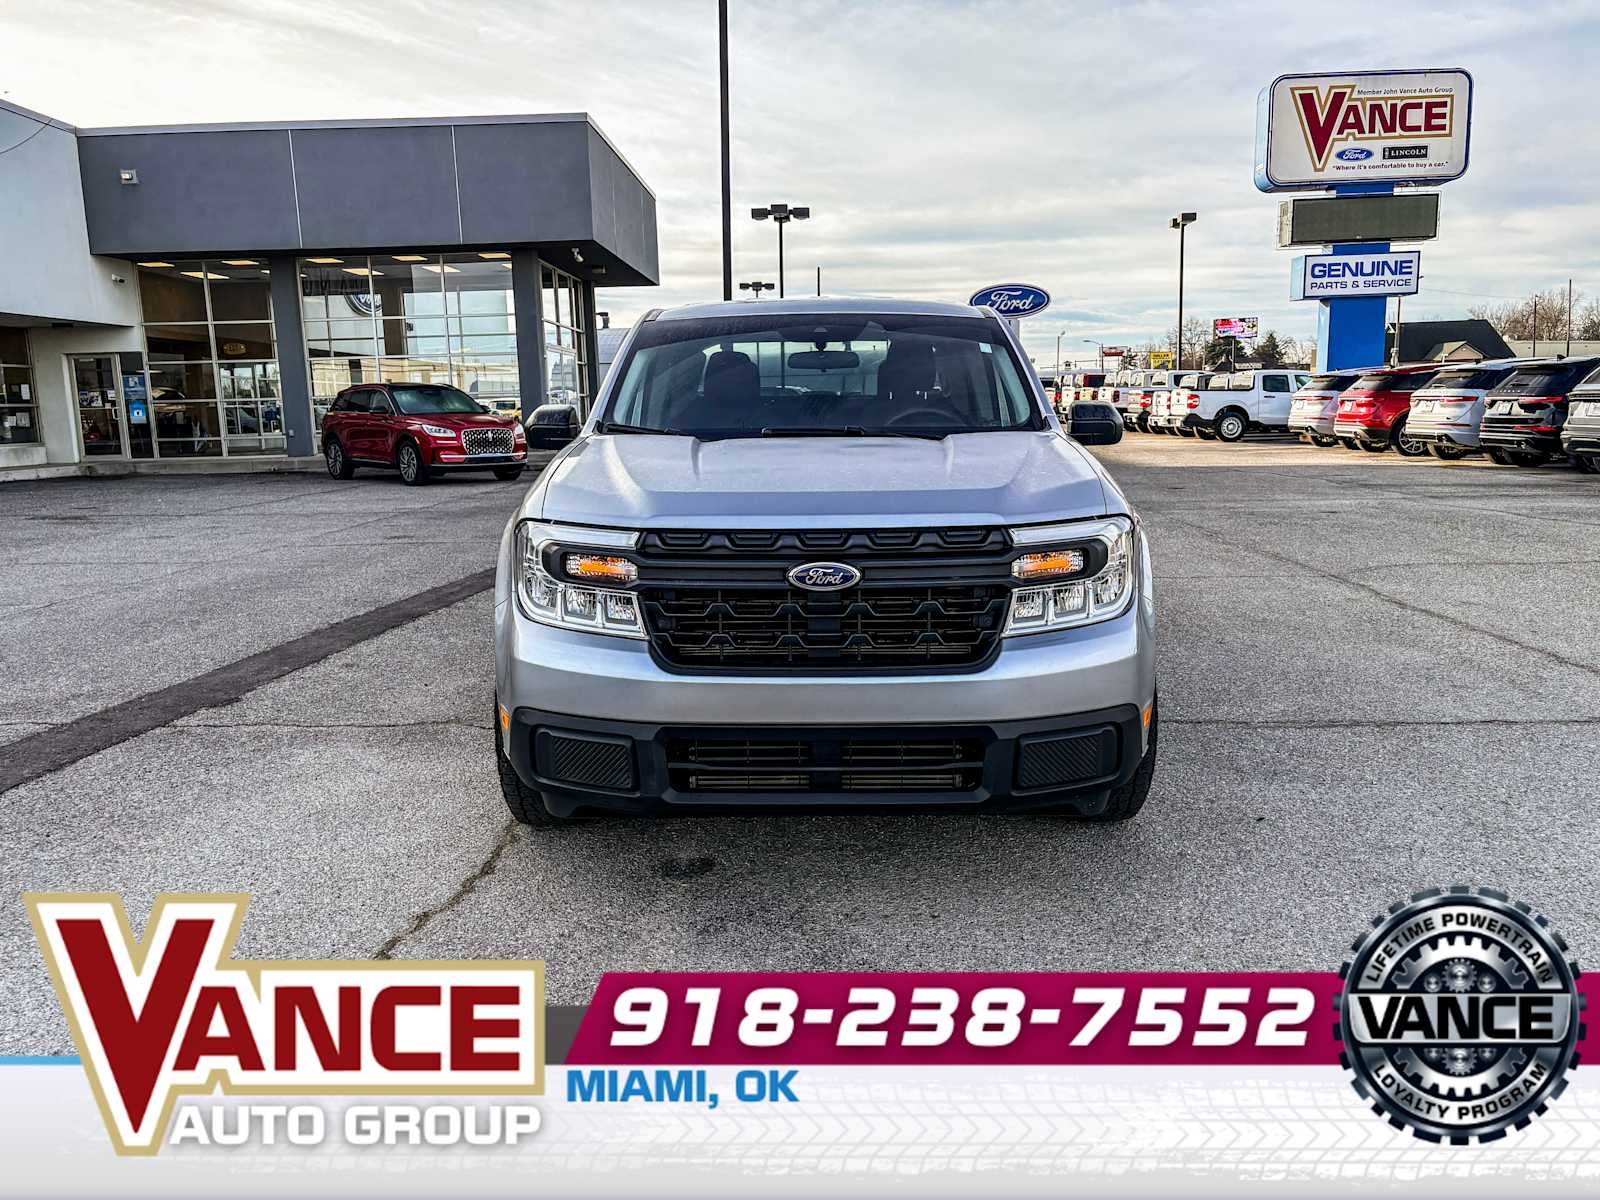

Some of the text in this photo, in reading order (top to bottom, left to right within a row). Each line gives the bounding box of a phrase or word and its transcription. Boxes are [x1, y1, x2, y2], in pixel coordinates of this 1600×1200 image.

[1298, 91, 1448, 164] VANCE
[1342, 150, 1367, 160] Ford
[1310, 260, 1414, 278] GENUINE
[1310, 280, 1348, 290] PARTS
[1364, 278, 1412, 288] SERVICE
[987, 290, 1034, 310] Ford
[806, 568, 844, 584] Ford
